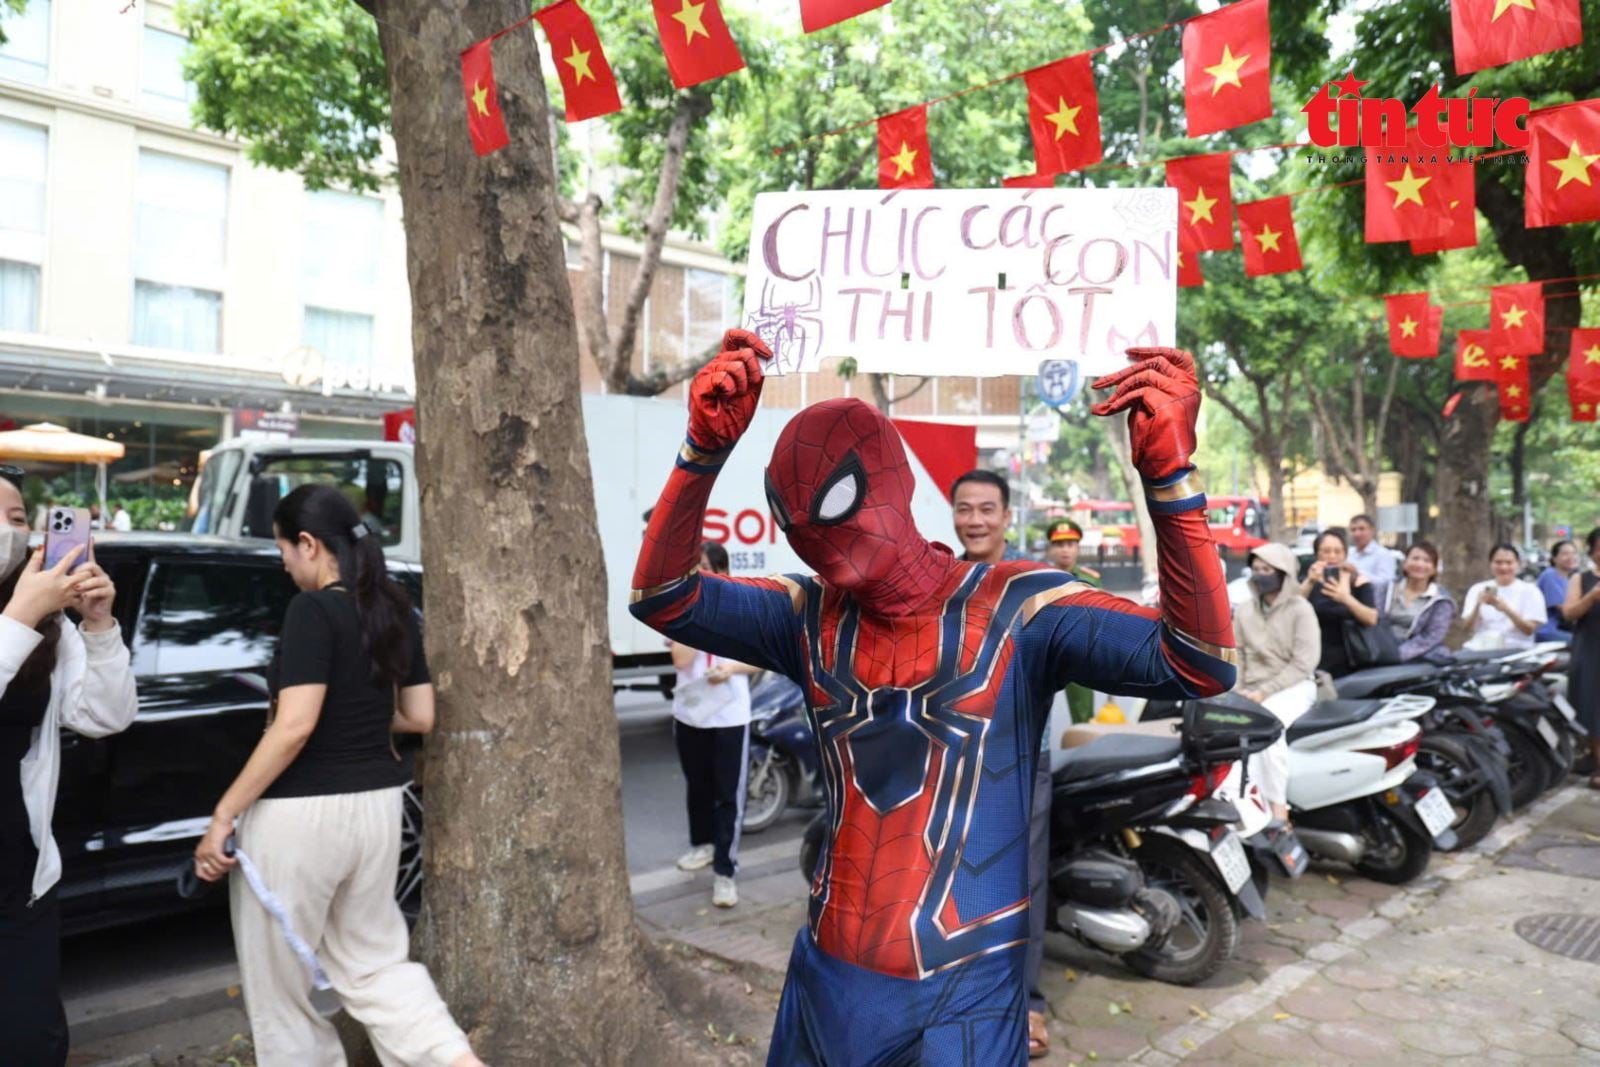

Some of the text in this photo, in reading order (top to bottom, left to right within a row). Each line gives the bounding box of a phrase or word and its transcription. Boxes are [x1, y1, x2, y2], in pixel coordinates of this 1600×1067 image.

[762, 190, 947, 282] CHÚC
[1043, 232, 1172, 286] CON
[838, 288, 934, 343] THI
